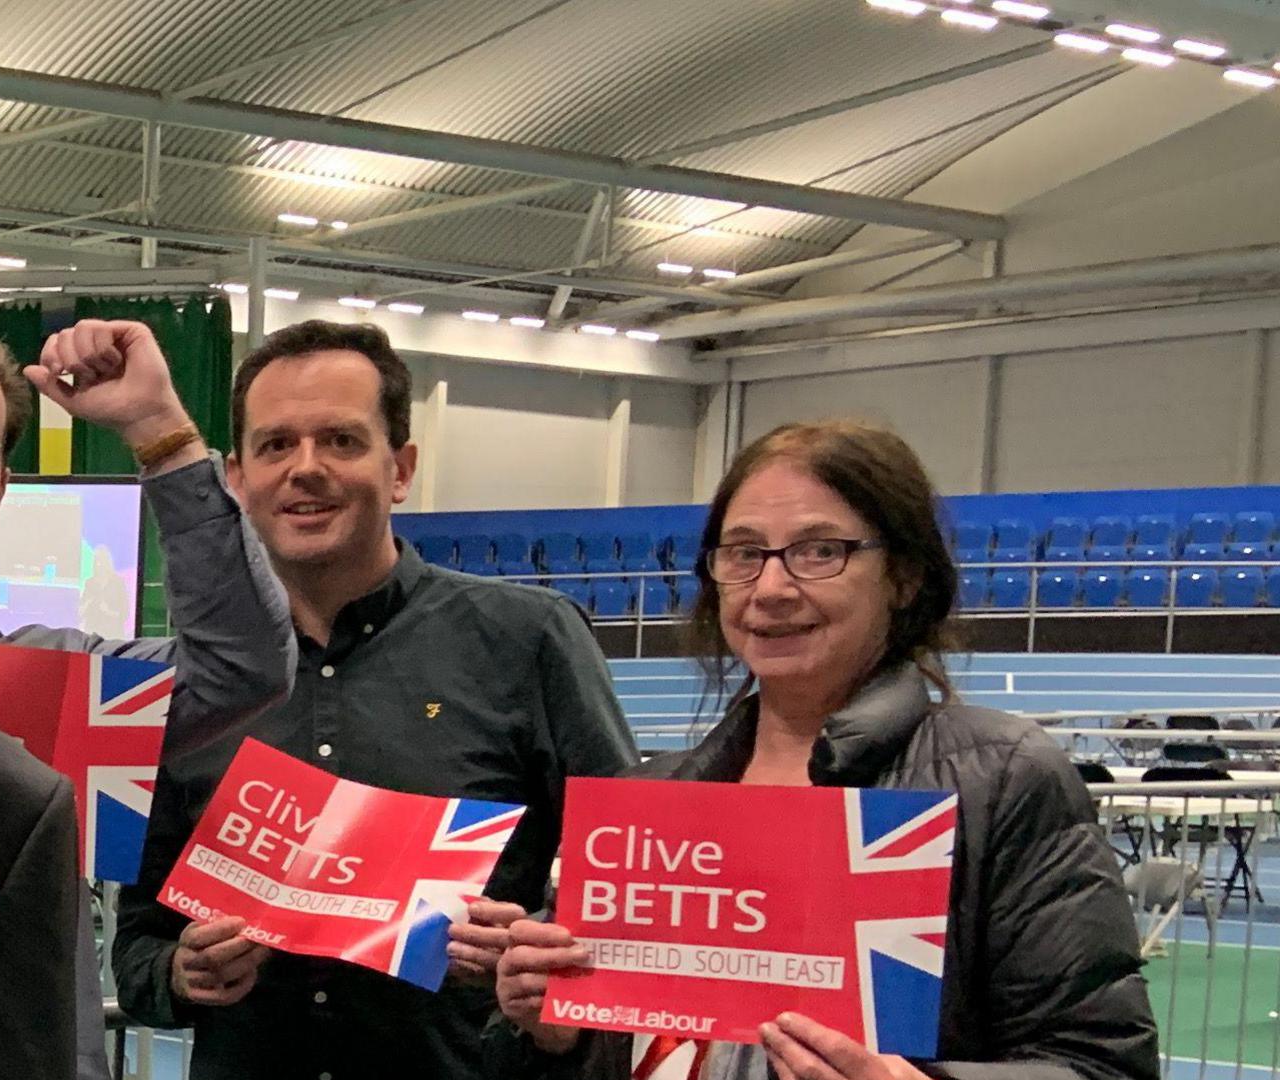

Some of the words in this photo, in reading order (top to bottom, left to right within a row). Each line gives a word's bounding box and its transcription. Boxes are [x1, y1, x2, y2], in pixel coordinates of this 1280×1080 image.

[238, 780, 321, 834] Cliv
[216, 811, 363, 885] BETTS
[584, 824, 723, 875] Clive
[166, 886, 213, 922] Vote
[192, 850, 280, 901] SHEFFIELD
[288, 890, 349, 912] SOUTH
[351, 900, 394, 918] EAST
[580, 879, 767, 932] BETTS
[587, 941, 682, 970] HEFFIELD
[694, 949, 772, 978] SOUTH
[784, 957, 841, 984] EAST
[551, 998, 616, 1024] Vote
[633, 1007, 718, 1034] Labour
